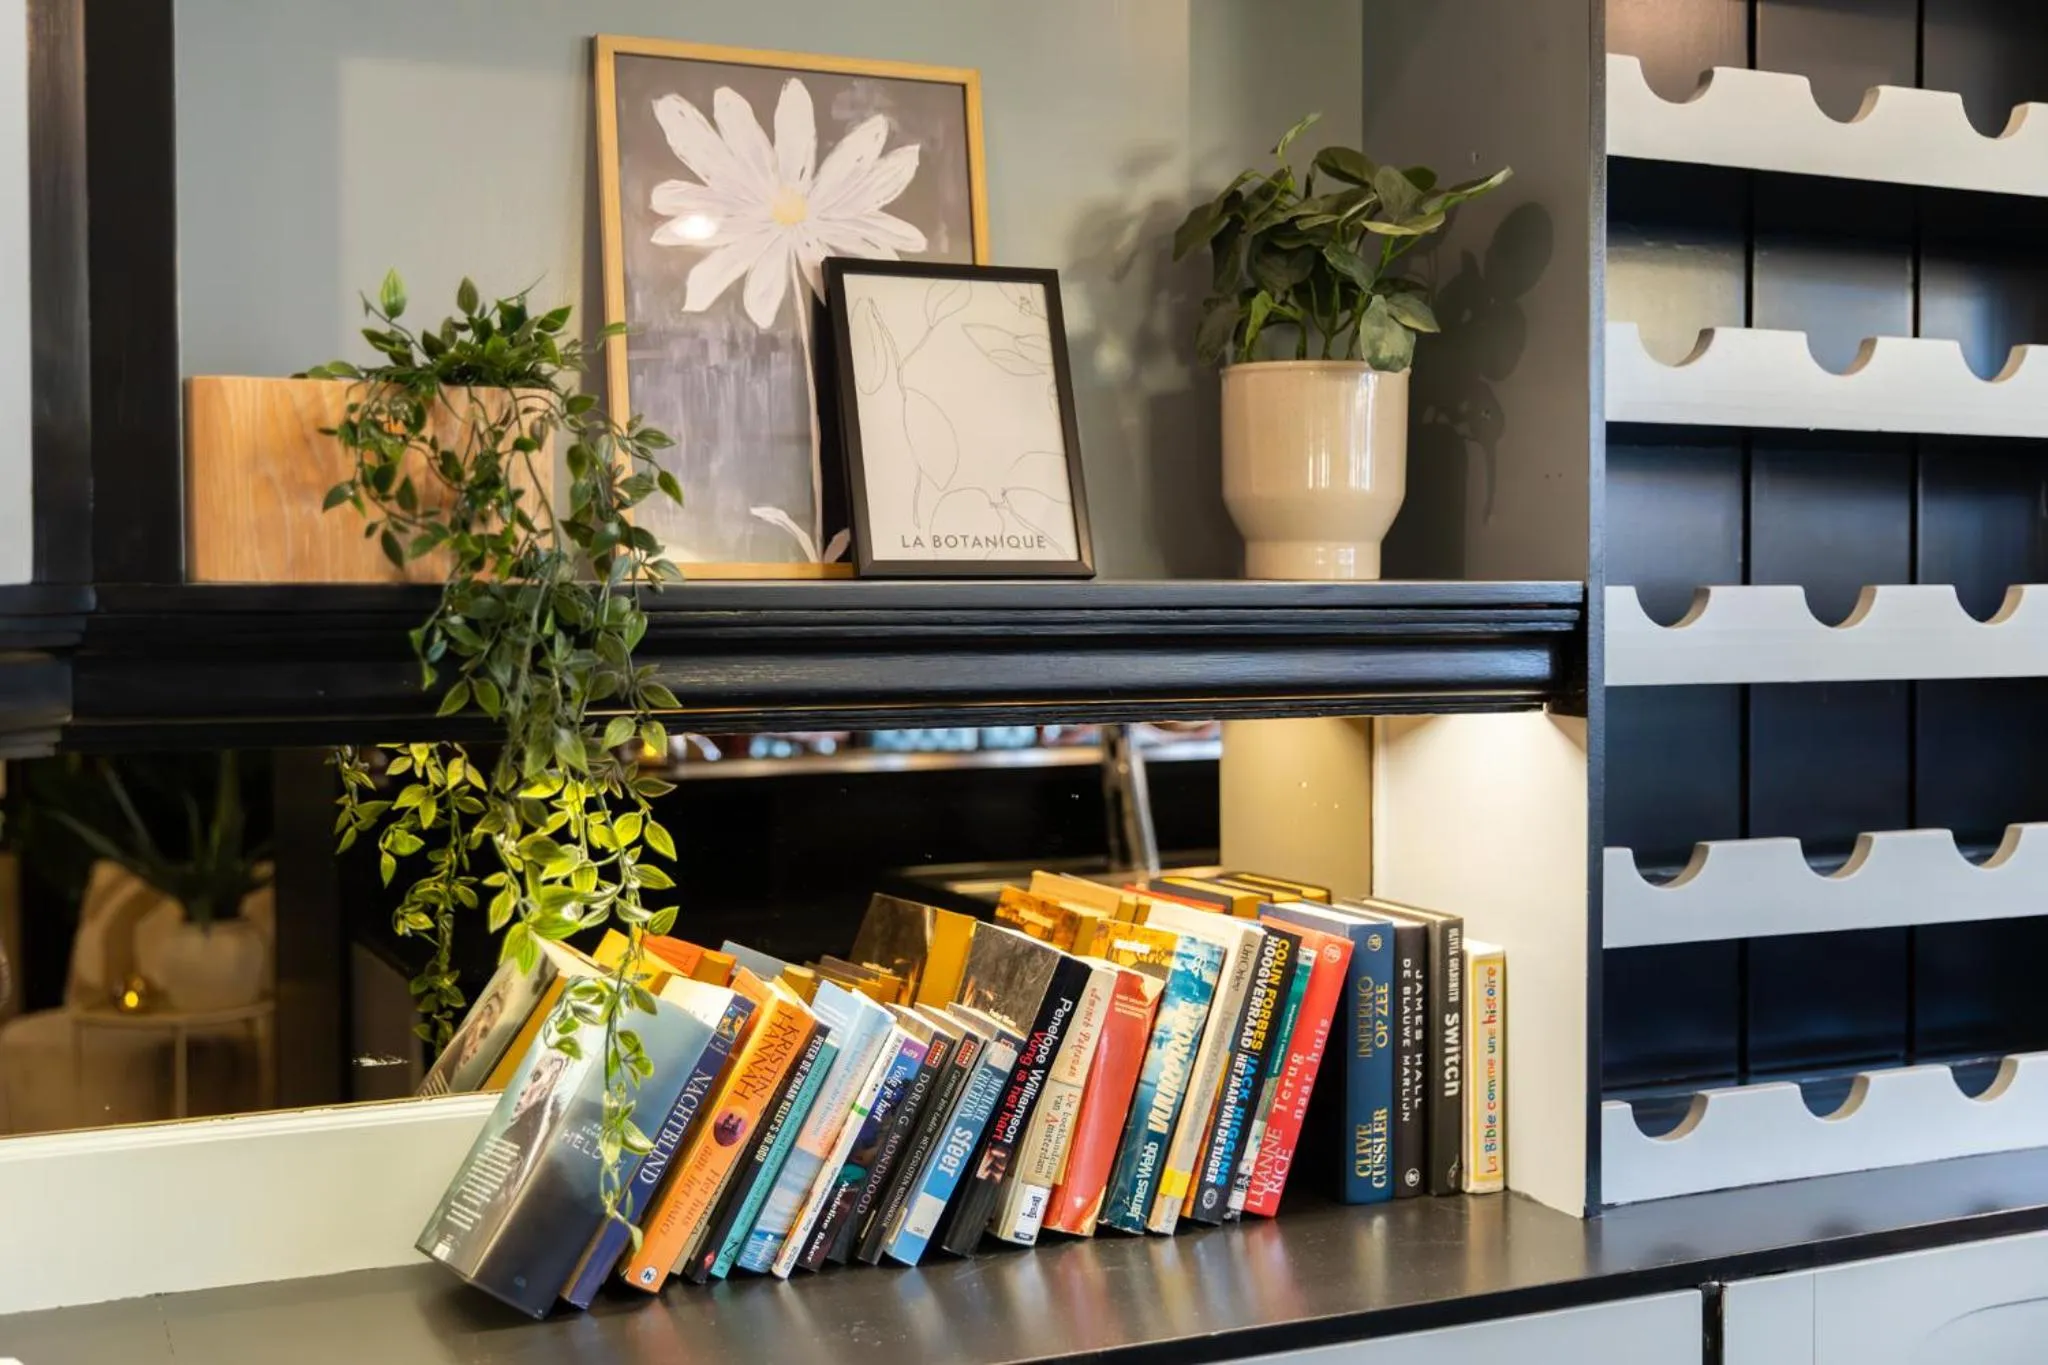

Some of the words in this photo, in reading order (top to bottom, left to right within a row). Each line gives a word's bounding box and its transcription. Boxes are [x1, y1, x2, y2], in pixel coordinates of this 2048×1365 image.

[902, 535, 924, 548] LA
[932, 535, 1047, 549] BOTANIQUE
[1269, 939, 1290, 986] COLIN
[1402, 958, 1411, 978] DE
[1241, 935, 1280, 1049] HOOGVERRAAD
[1375, 983, 1389, 1016] ZEE
[1415, 970, 1424, 1041] JAMES
[1482, 967, 1497, 1025] histoire
[1036, 998, 1073, 1064] Penelope
[1251, 988, 1277, 1051] FORBES
[1375, 1020, 1389, 1048] OP
[1402, 986, 1411, 1046] BLAUWE
[733, 1009, 794, 1100] HANNAH
[751, 1024, 800, 1098] KRISTIN
[805, 1034, 825, 1060] PETER
[1487, 1028, 1496, 1053] une
[799, 1059, 812, 1072] DE
[886, 1065, 907, 1088] Volg
[1233, 1053, 1248, 1075] HET
[1238, 1056, 1258, 1100] JACK
[1271, 1053, 1304, 1113] Terug
[1294, 1073, 1314, 1120] naar
[1305, 1018, 1329, 1063] huis
[1414, 1053, 1423, 1110] HALL
[1487, 1059, 1496, 1110] comme
[872, 1099, 891, 1122] hart
[883, 1085, 897, 1099] je
[905, 1072, 930, 1114] DORIS
[960, 1068, 992, 1119] CRICHTON
[973, 1077, 1004, 1122] MICHAEL
[1002, 1069, 1046, 1144] Williamson
[1005, 1085, 1024, 1109] het
[1225, 1075, 1242, 1107] JAAR
[640, 1069, 713, 1184] NACHTBLIND
[992, 1111, 1014, 1140] hart
[1214, 1128, 1228, 1146] DE
[1220, 1106, 1236, 1129] VAN
[1484, 1115, 1497, 1153] Bible
[1136, 1141, 1159, 1180] Webb
[1214, 1105, 1245, 1186] HIGGINS
[1248, 1126, 1282, 1208] LUANNE
[1355, 1123, 1372, 1177] CLIVE
[1372, 1107, 1388, 1188] CUSSLER
[1487, 1155, 1497, 1173] La
[856, 1132, 901, 1215] MONDDOOD
[1265, 1148, 1291, 1194] RICE
[821, 1180, 850, 1229] Madeline
[1126, 1180, 1149, 1221] James
[807, 1231, 825, 1264] Baker
